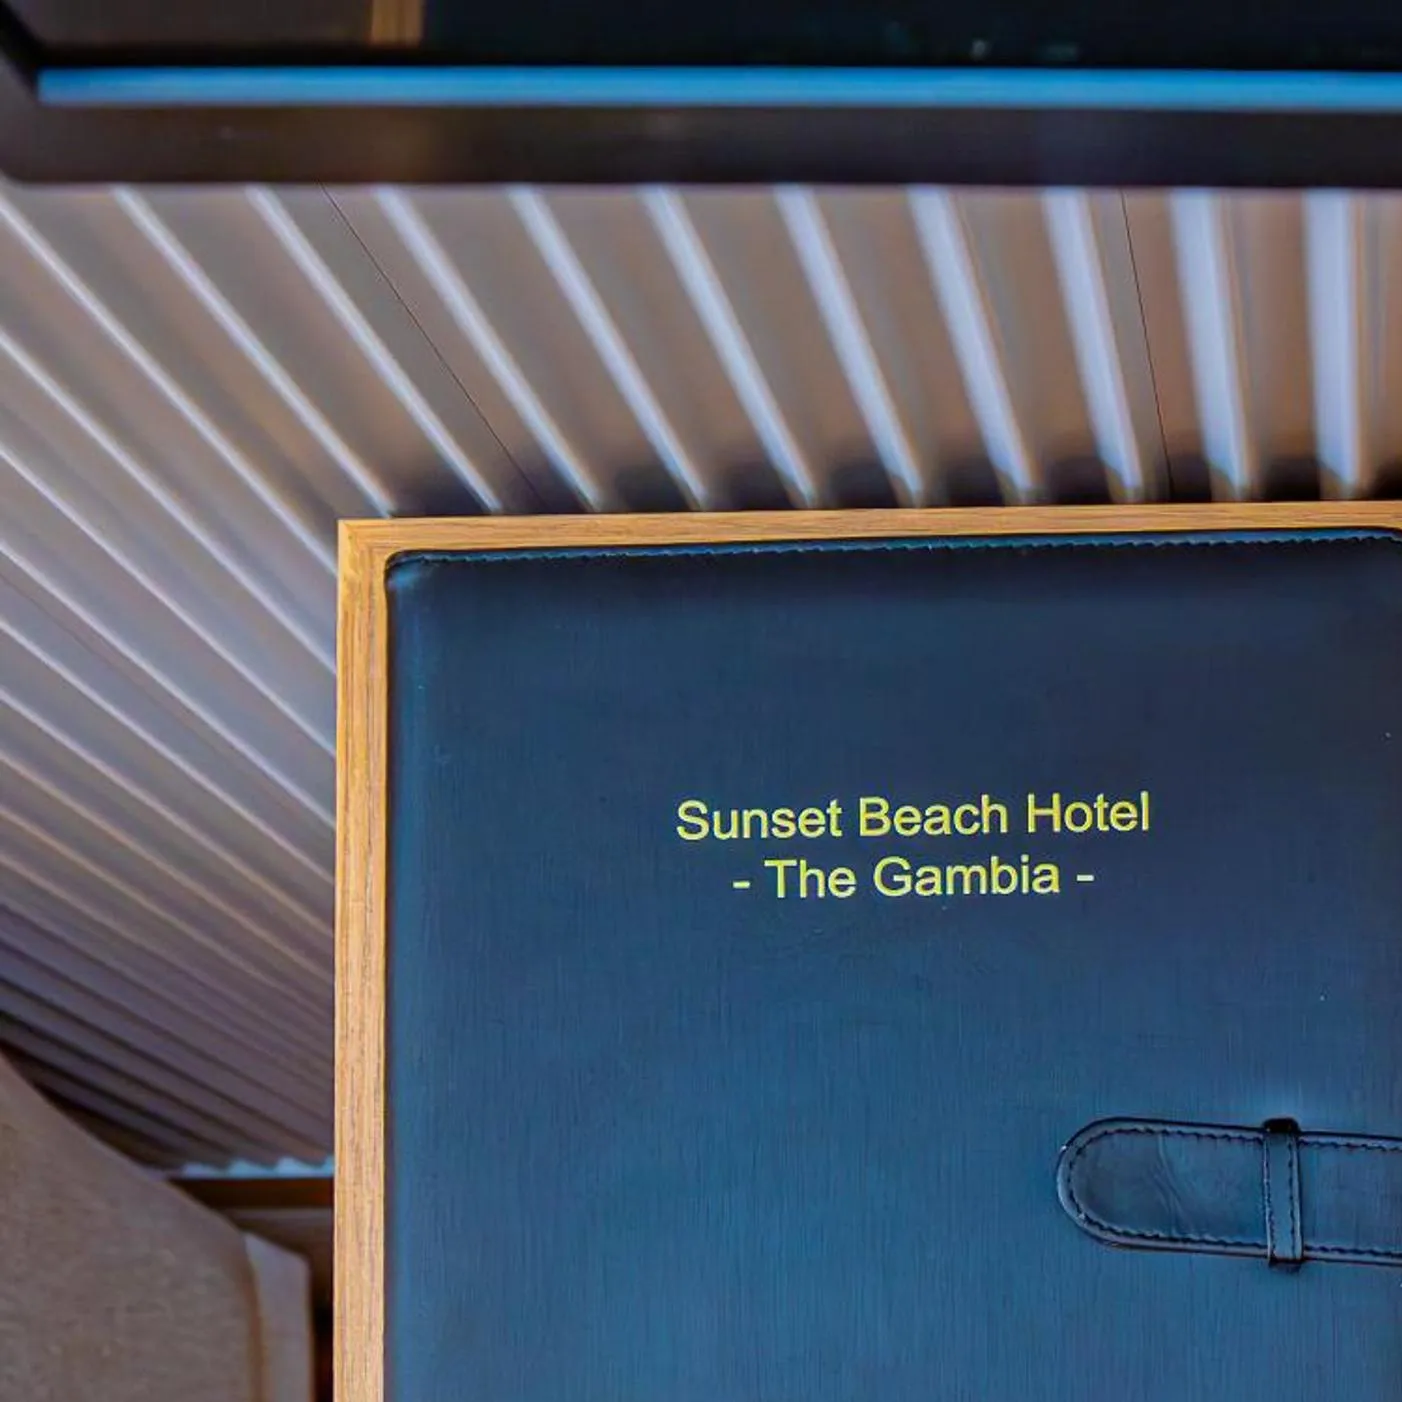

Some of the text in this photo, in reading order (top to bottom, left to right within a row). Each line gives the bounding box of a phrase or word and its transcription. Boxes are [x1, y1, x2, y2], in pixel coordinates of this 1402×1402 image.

[677, 791, 1150, 840] Sunset Beach Hotel
[764, 859, 856, 898] The
[873, 854, 1060, 897] Gambia
